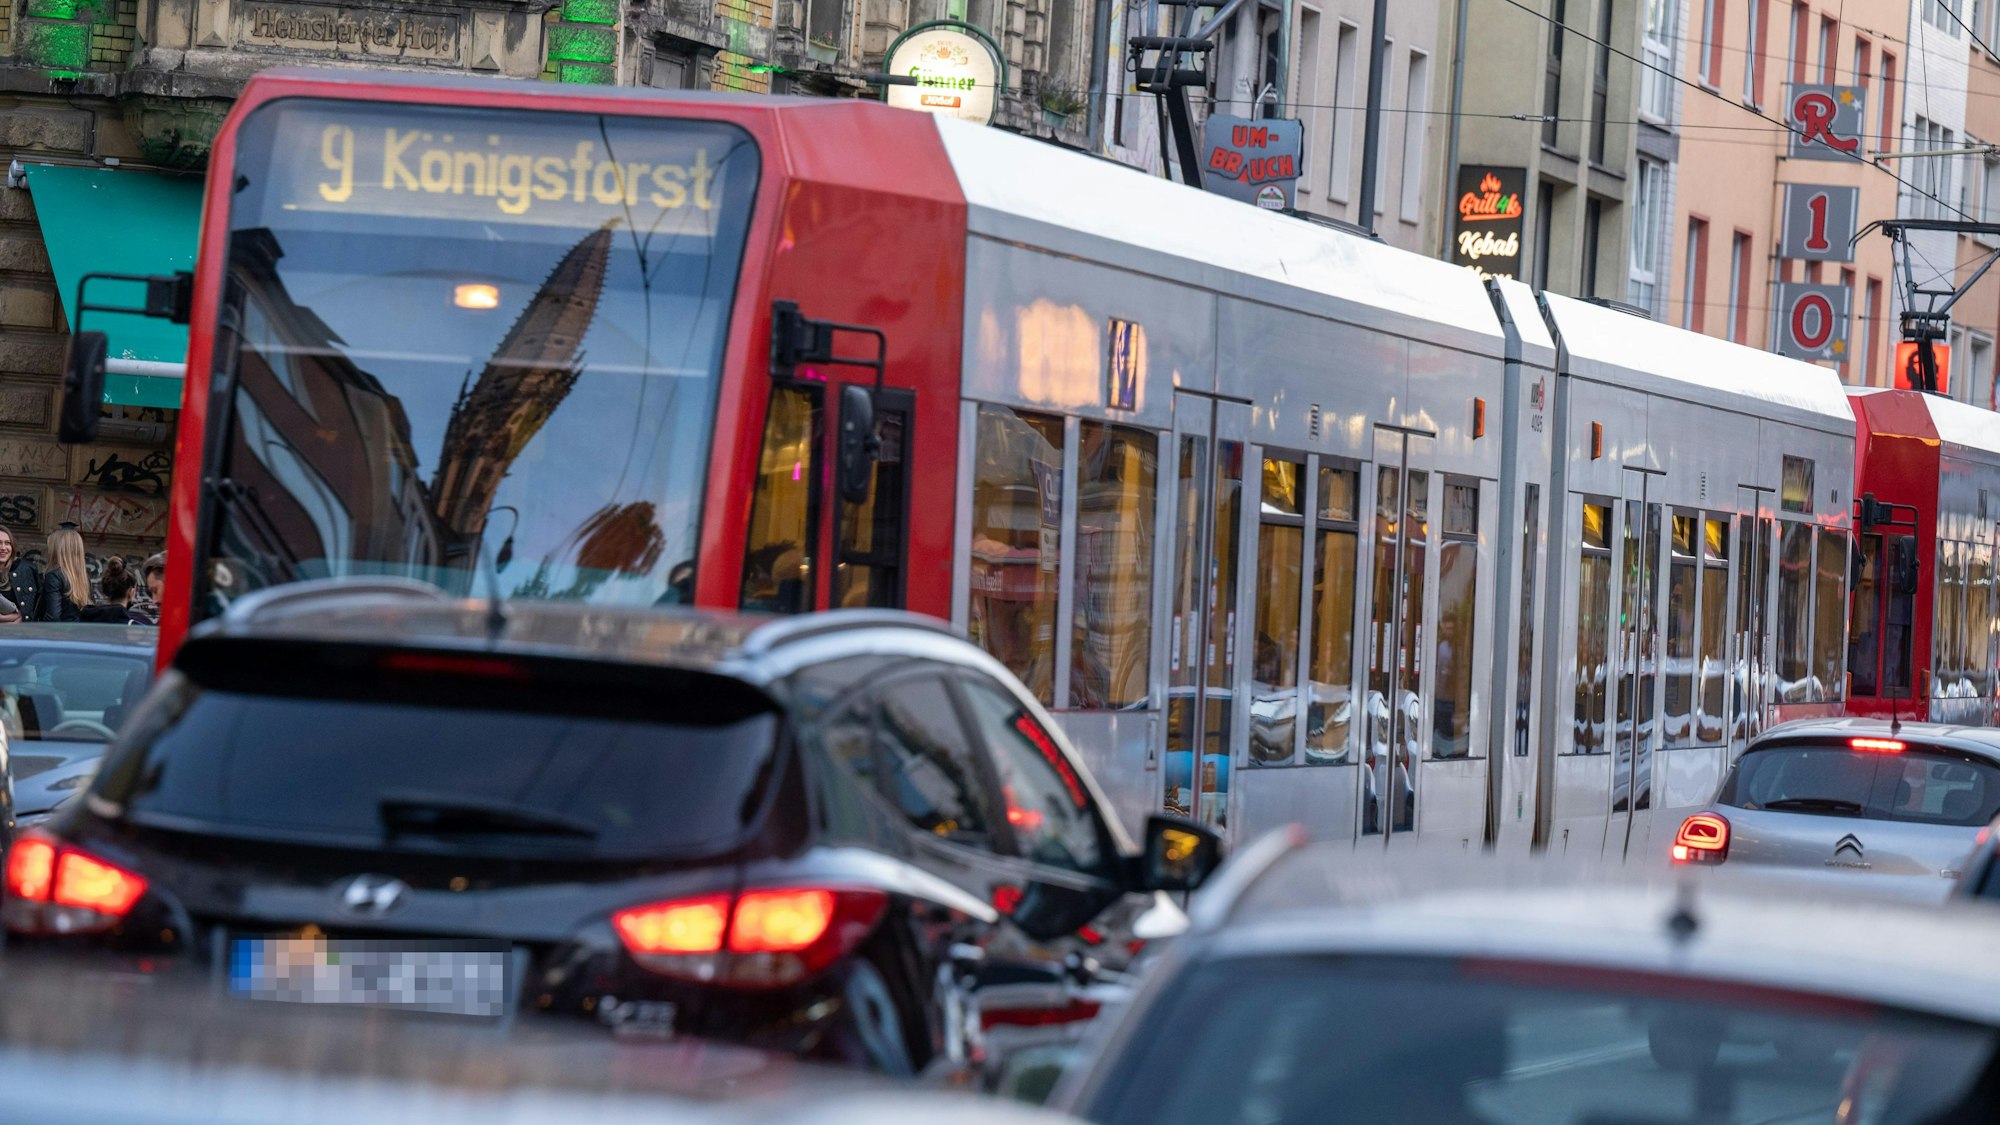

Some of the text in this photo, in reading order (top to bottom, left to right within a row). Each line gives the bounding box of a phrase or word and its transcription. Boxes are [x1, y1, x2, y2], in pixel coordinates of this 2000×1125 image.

[252, 7, 450, 54] Heinsberger Hof.
[1232, 125, 1279, 148] UM-
[319, 125, 713, 214] 9 Königsforst
[1458, 231, 1519, 259] Kebab
